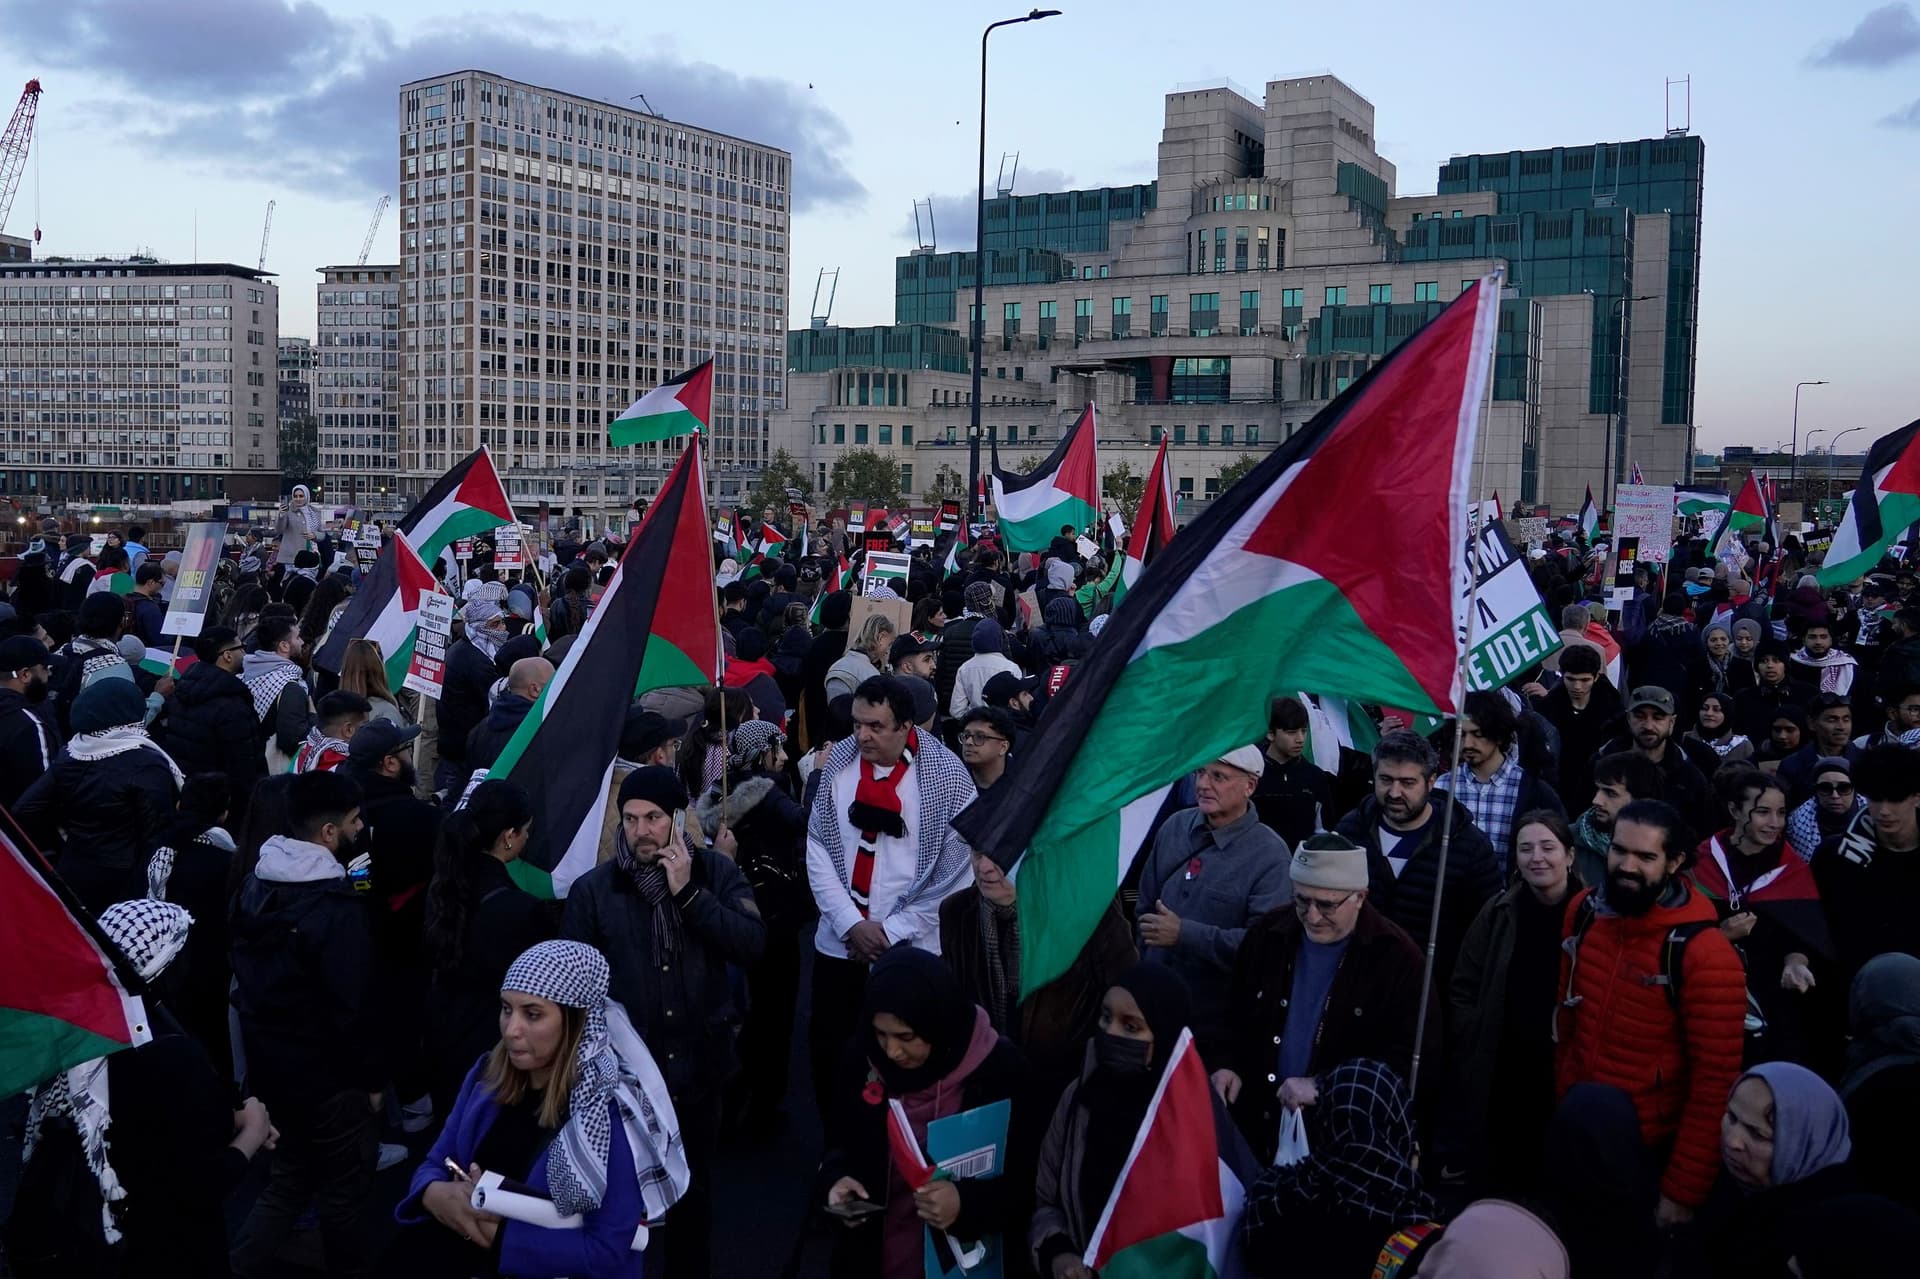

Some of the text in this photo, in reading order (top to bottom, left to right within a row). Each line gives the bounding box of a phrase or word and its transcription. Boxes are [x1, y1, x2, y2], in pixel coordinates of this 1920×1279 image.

[1619, 559, 1634, 574] SIEGE
[1485, 610, 1561, 680] IDEA
[1051, 666, 1065, 697] HILF
